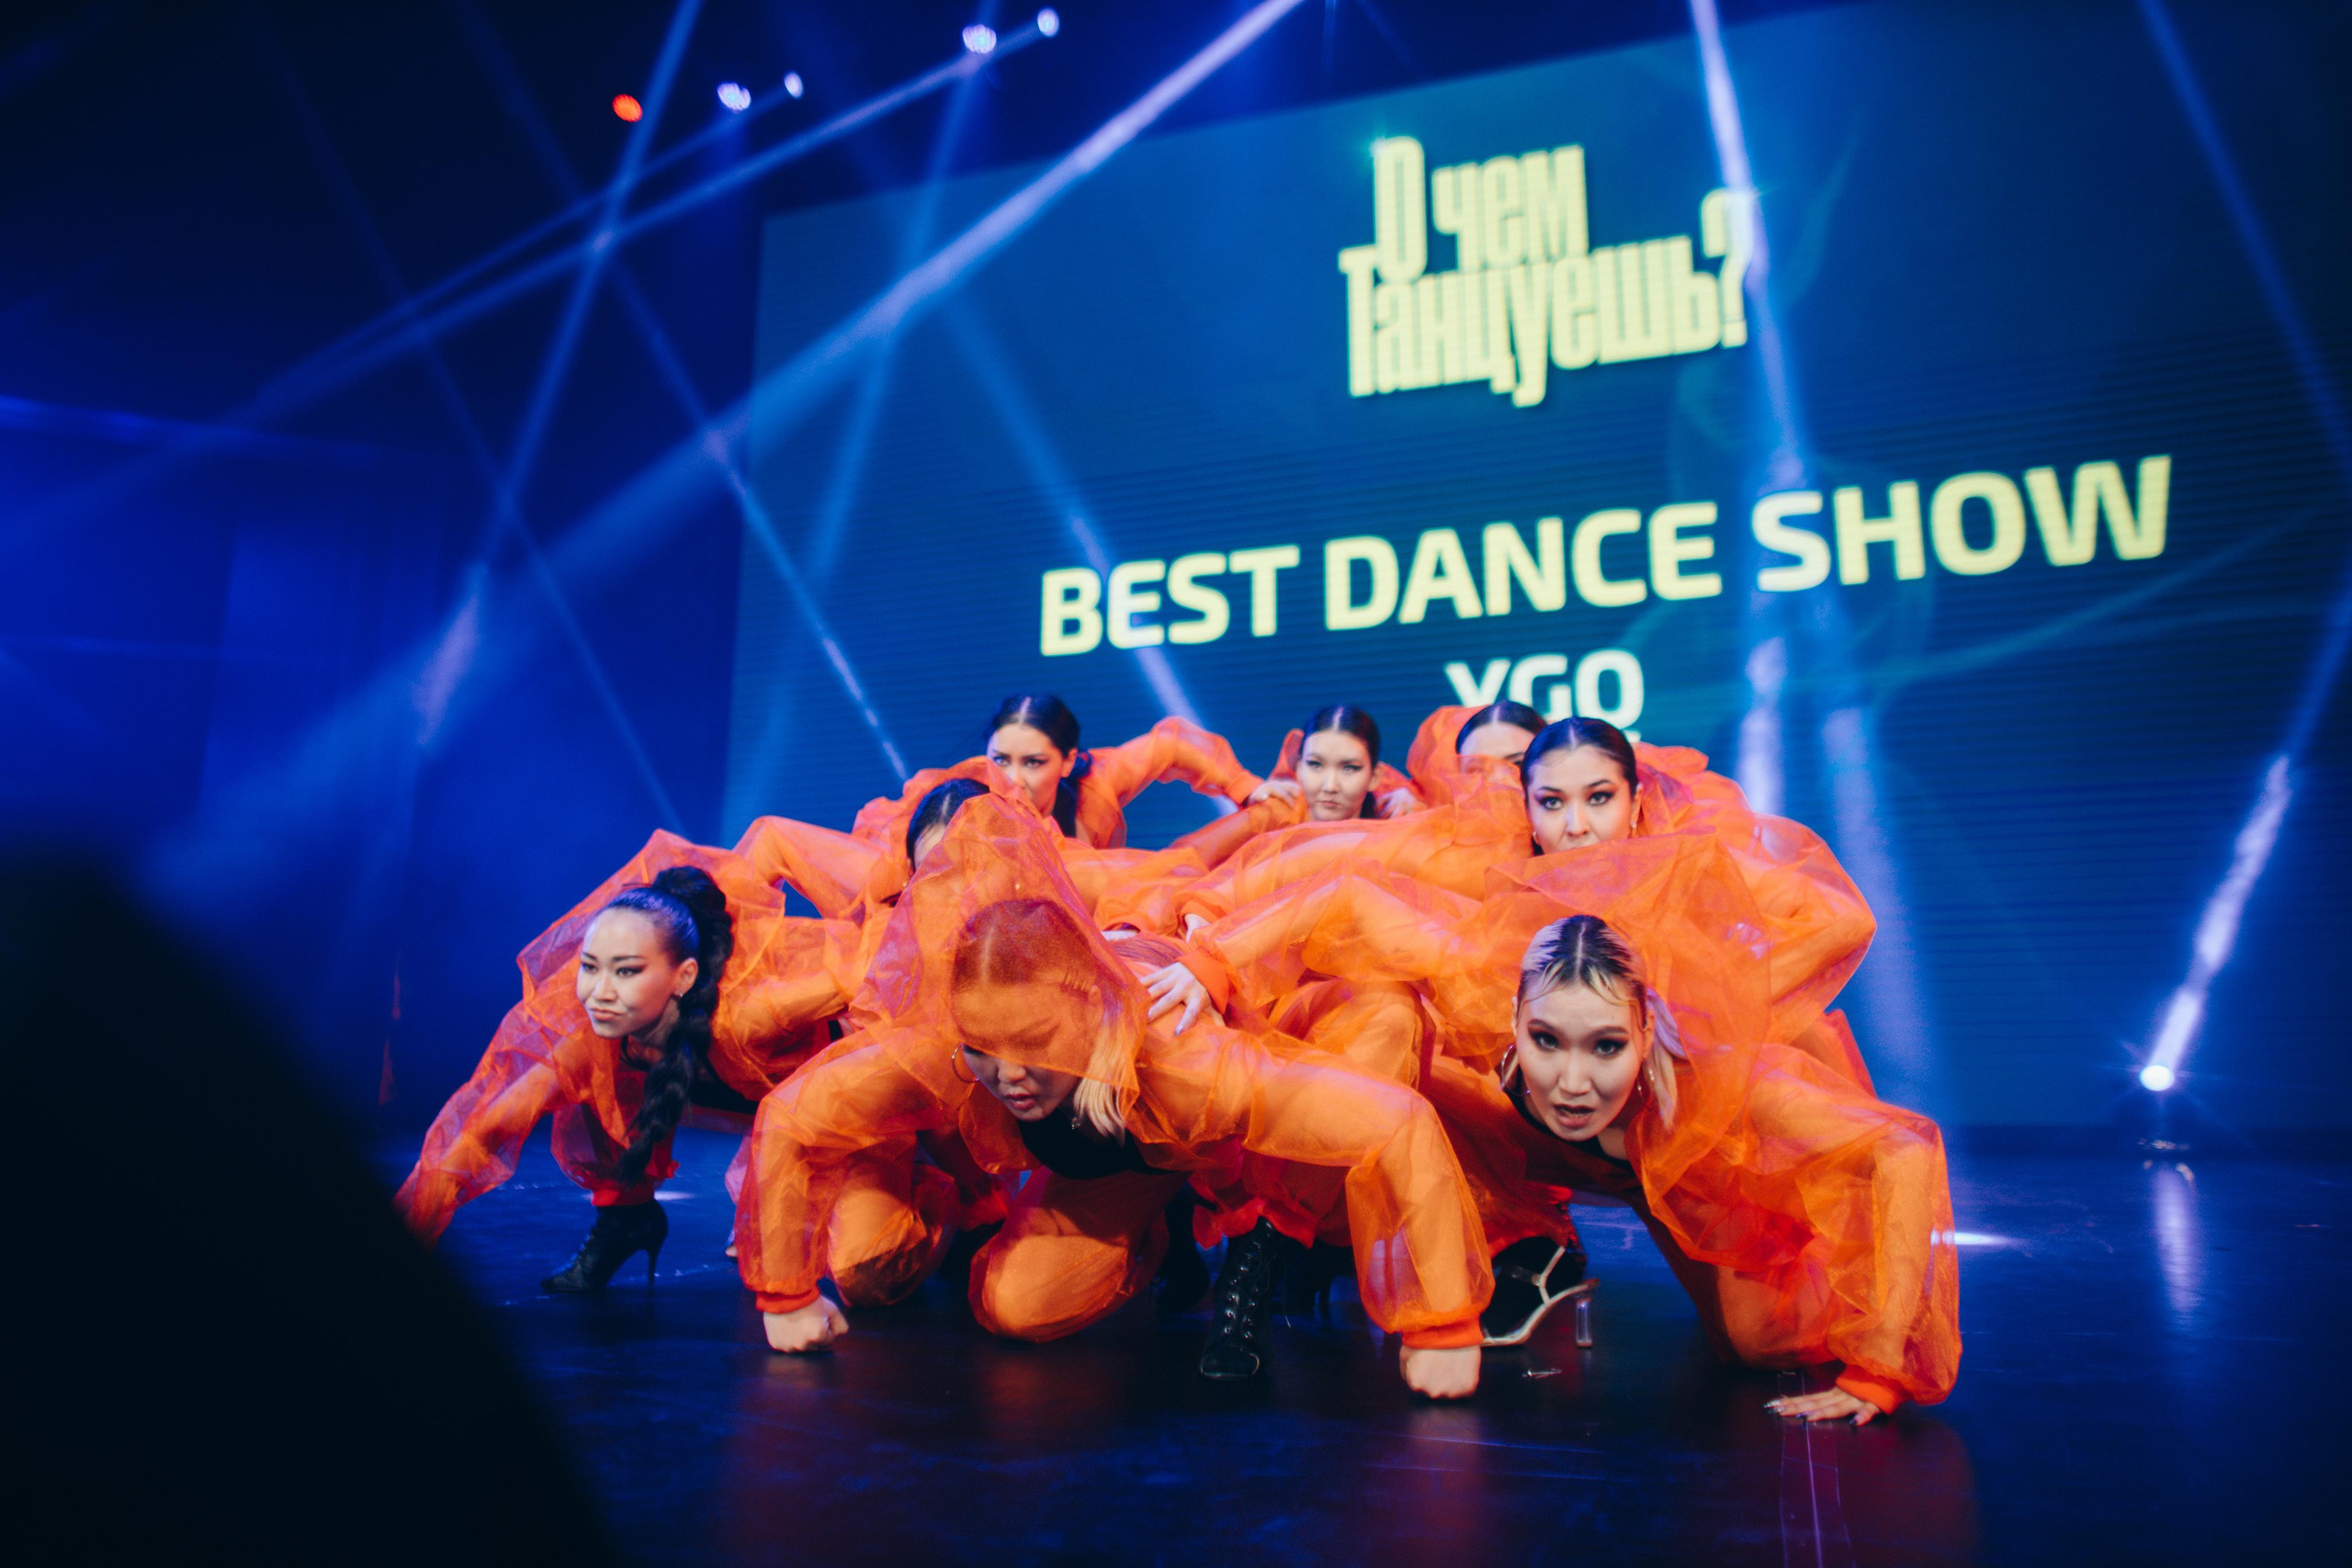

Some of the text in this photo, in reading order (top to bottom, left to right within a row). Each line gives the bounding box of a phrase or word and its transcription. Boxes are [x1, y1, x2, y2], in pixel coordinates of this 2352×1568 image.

[1339, 186, 1753, 407] Танцуешь?
[1374, 136, 1590, 283] О чем
[1040, 455, 2172, 656] BEST DANCE SHOW
